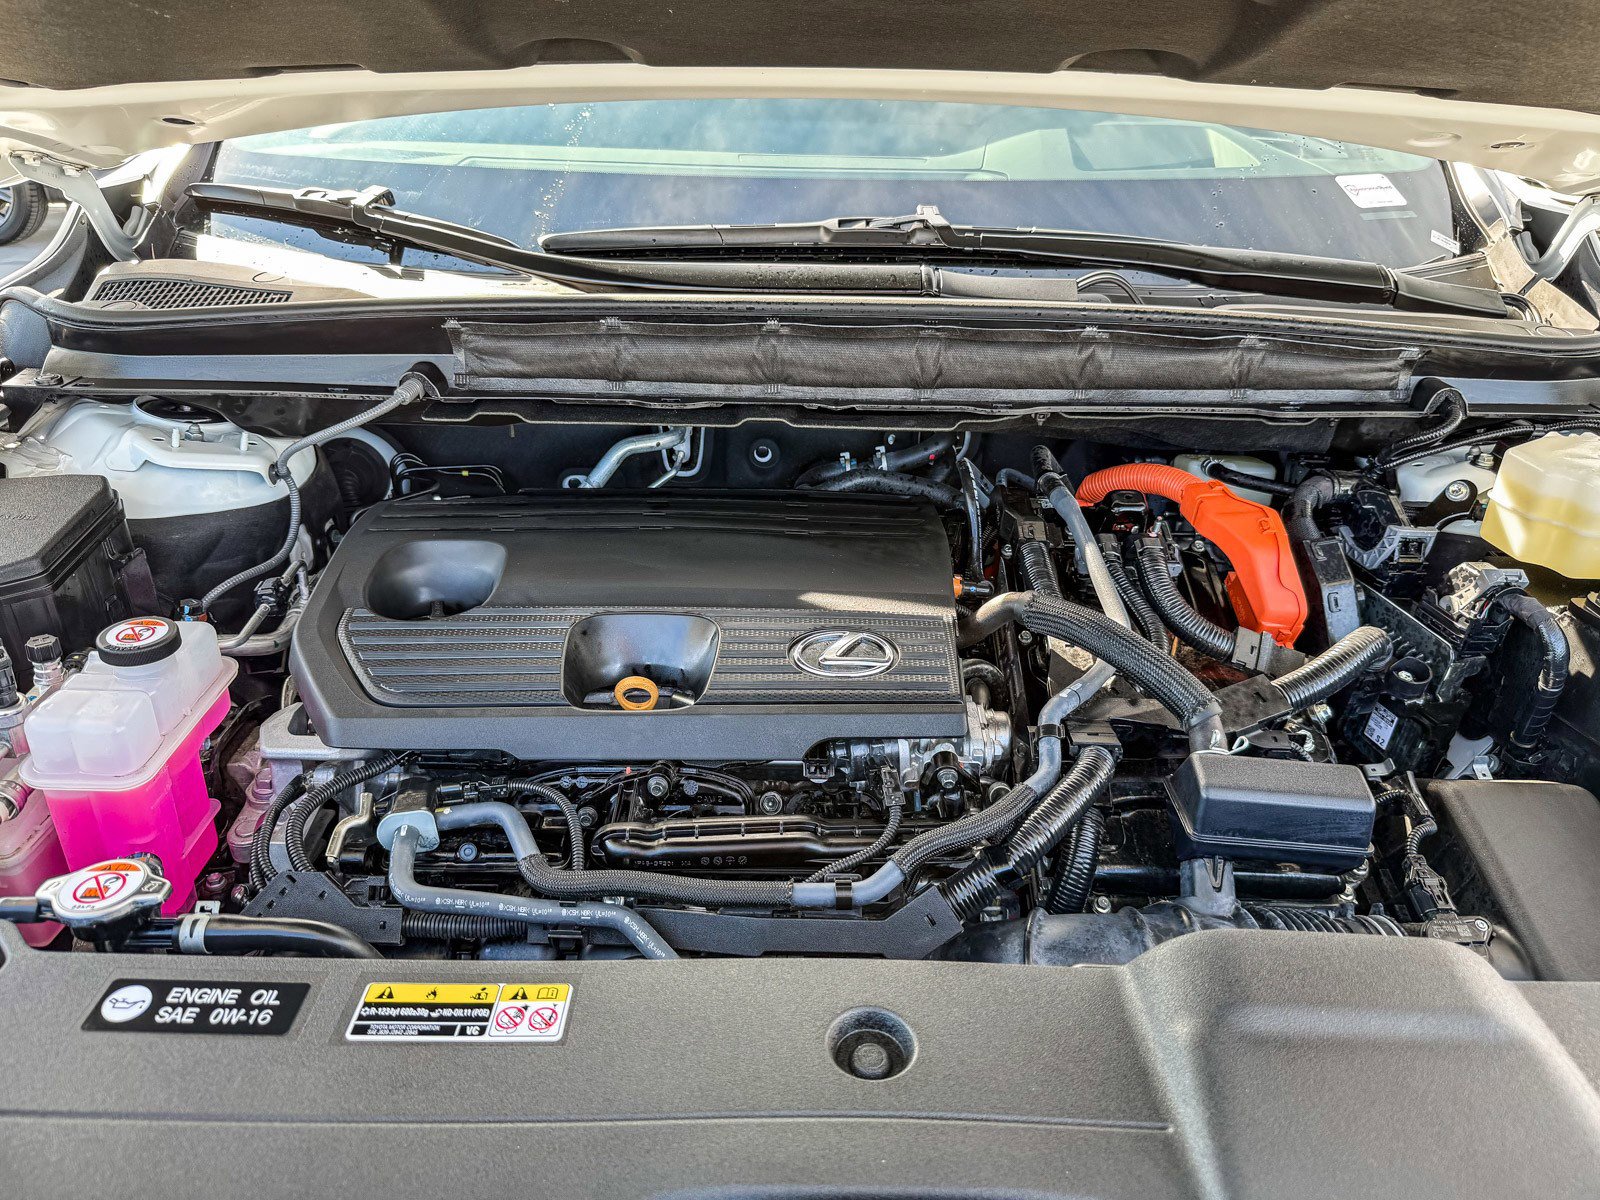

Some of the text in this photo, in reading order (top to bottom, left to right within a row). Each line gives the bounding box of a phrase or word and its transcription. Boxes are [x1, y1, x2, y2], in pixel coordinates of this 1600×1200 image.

[166, 987, 280, 1006] ENGINE OIL
[154, 1006, 273, 1025] SAE 0W-16
